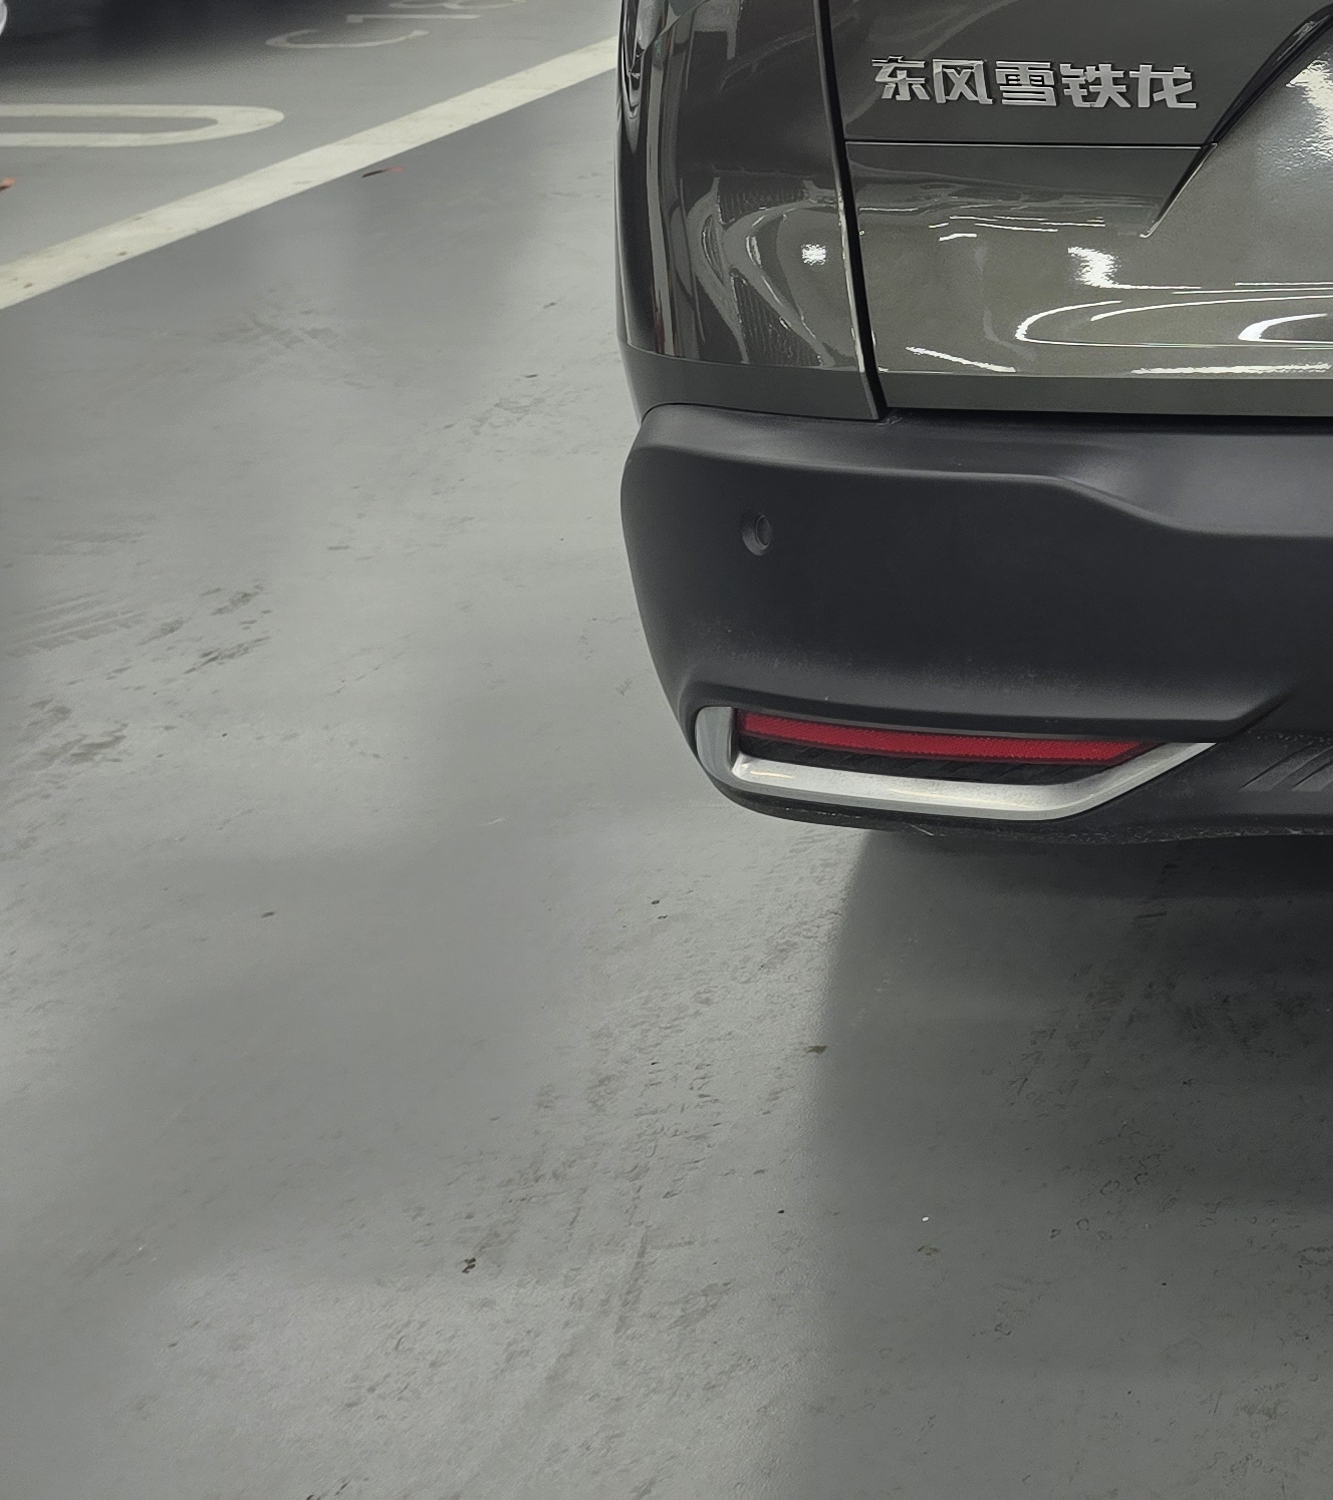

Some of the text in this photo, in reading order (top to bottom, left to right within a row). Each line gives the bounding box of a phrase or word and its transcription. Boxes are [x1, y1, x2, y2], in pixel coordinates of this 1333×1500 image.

[871, 55, 1198, 109] 东风雪铁龙
